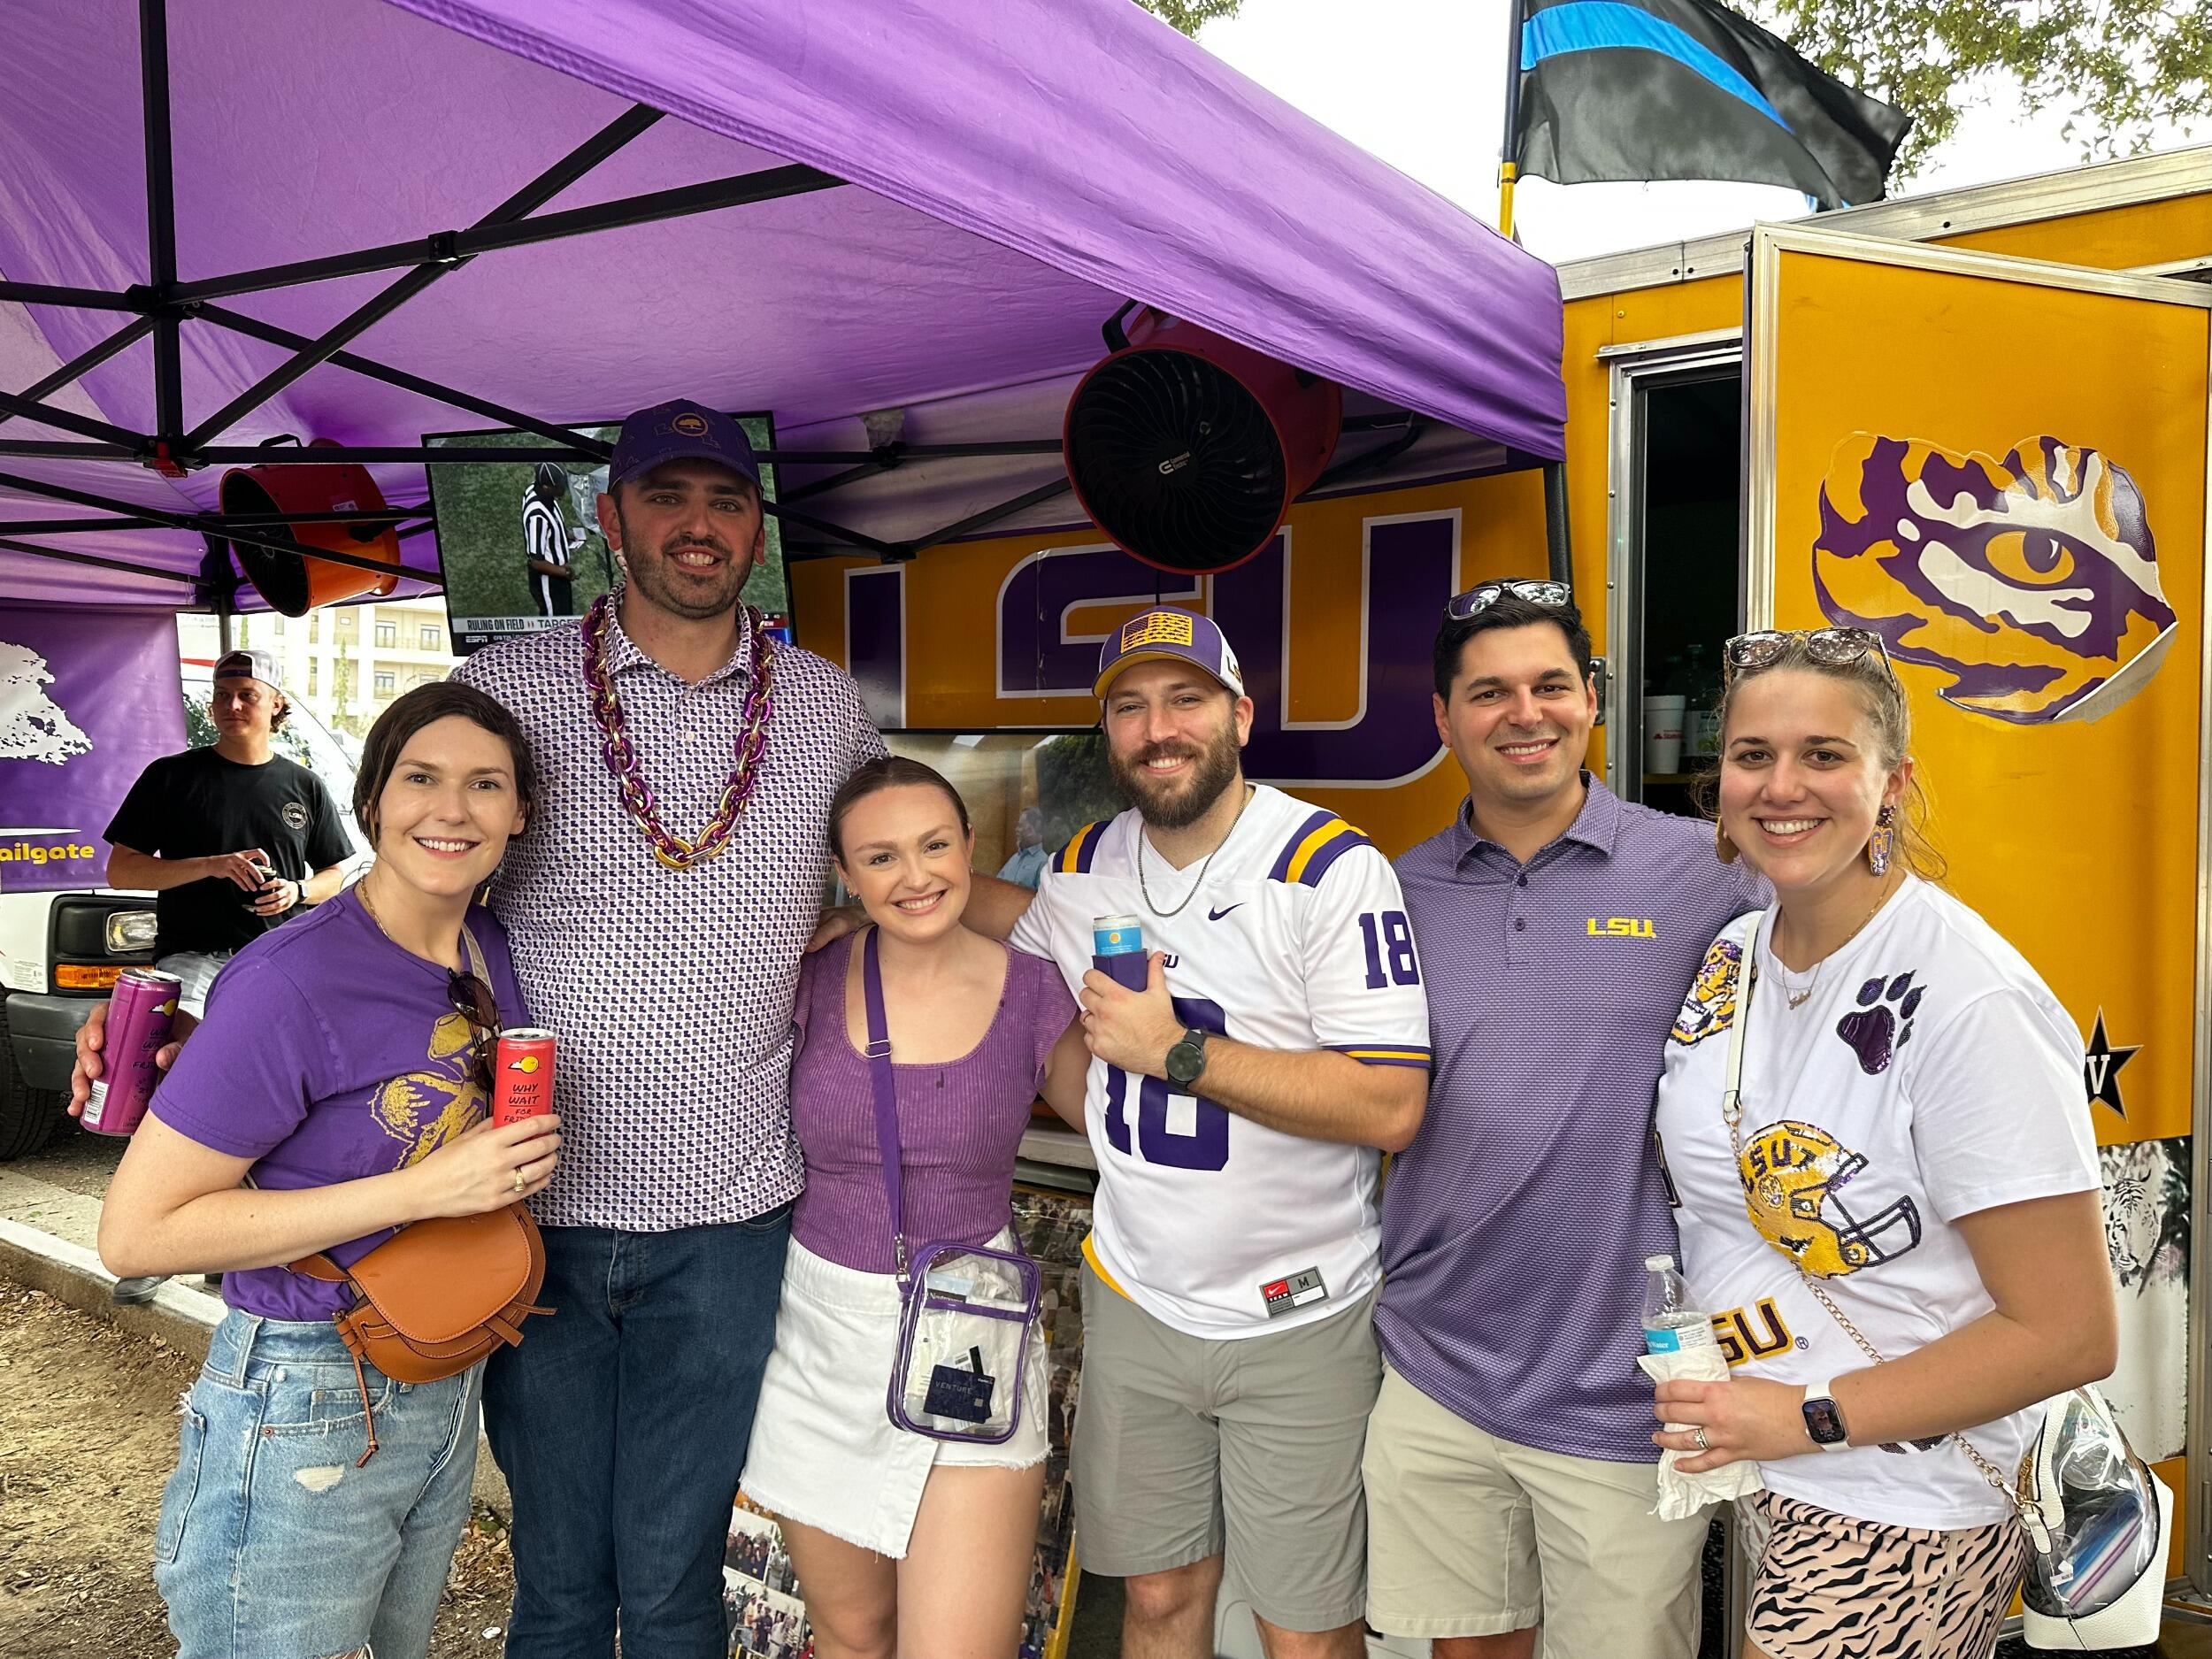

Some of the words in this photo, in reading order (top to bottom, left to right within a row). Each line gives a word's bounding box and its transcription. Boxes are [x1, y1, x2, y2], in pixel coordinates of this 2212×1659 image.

[467, 619, 493, 631] RULING
[494, 619, 505, 630] ON
[506, 618, 525, 630] FIELD
[538, 618, 581, 629] TARGE
[465, 635, 488, 644] ESPN
[1586, 918, 1654, 938] LSU
[1358, 910, 1419, 990] 18
[2085, 1054, 2111, 1094] V
[513, 1083, 539, 1092] WHY
[509, 1095, 540, 1104] WAIT
[1297, 1276, 1310, 1289] M
[934, 1380, 973, 1394] VENTURE
